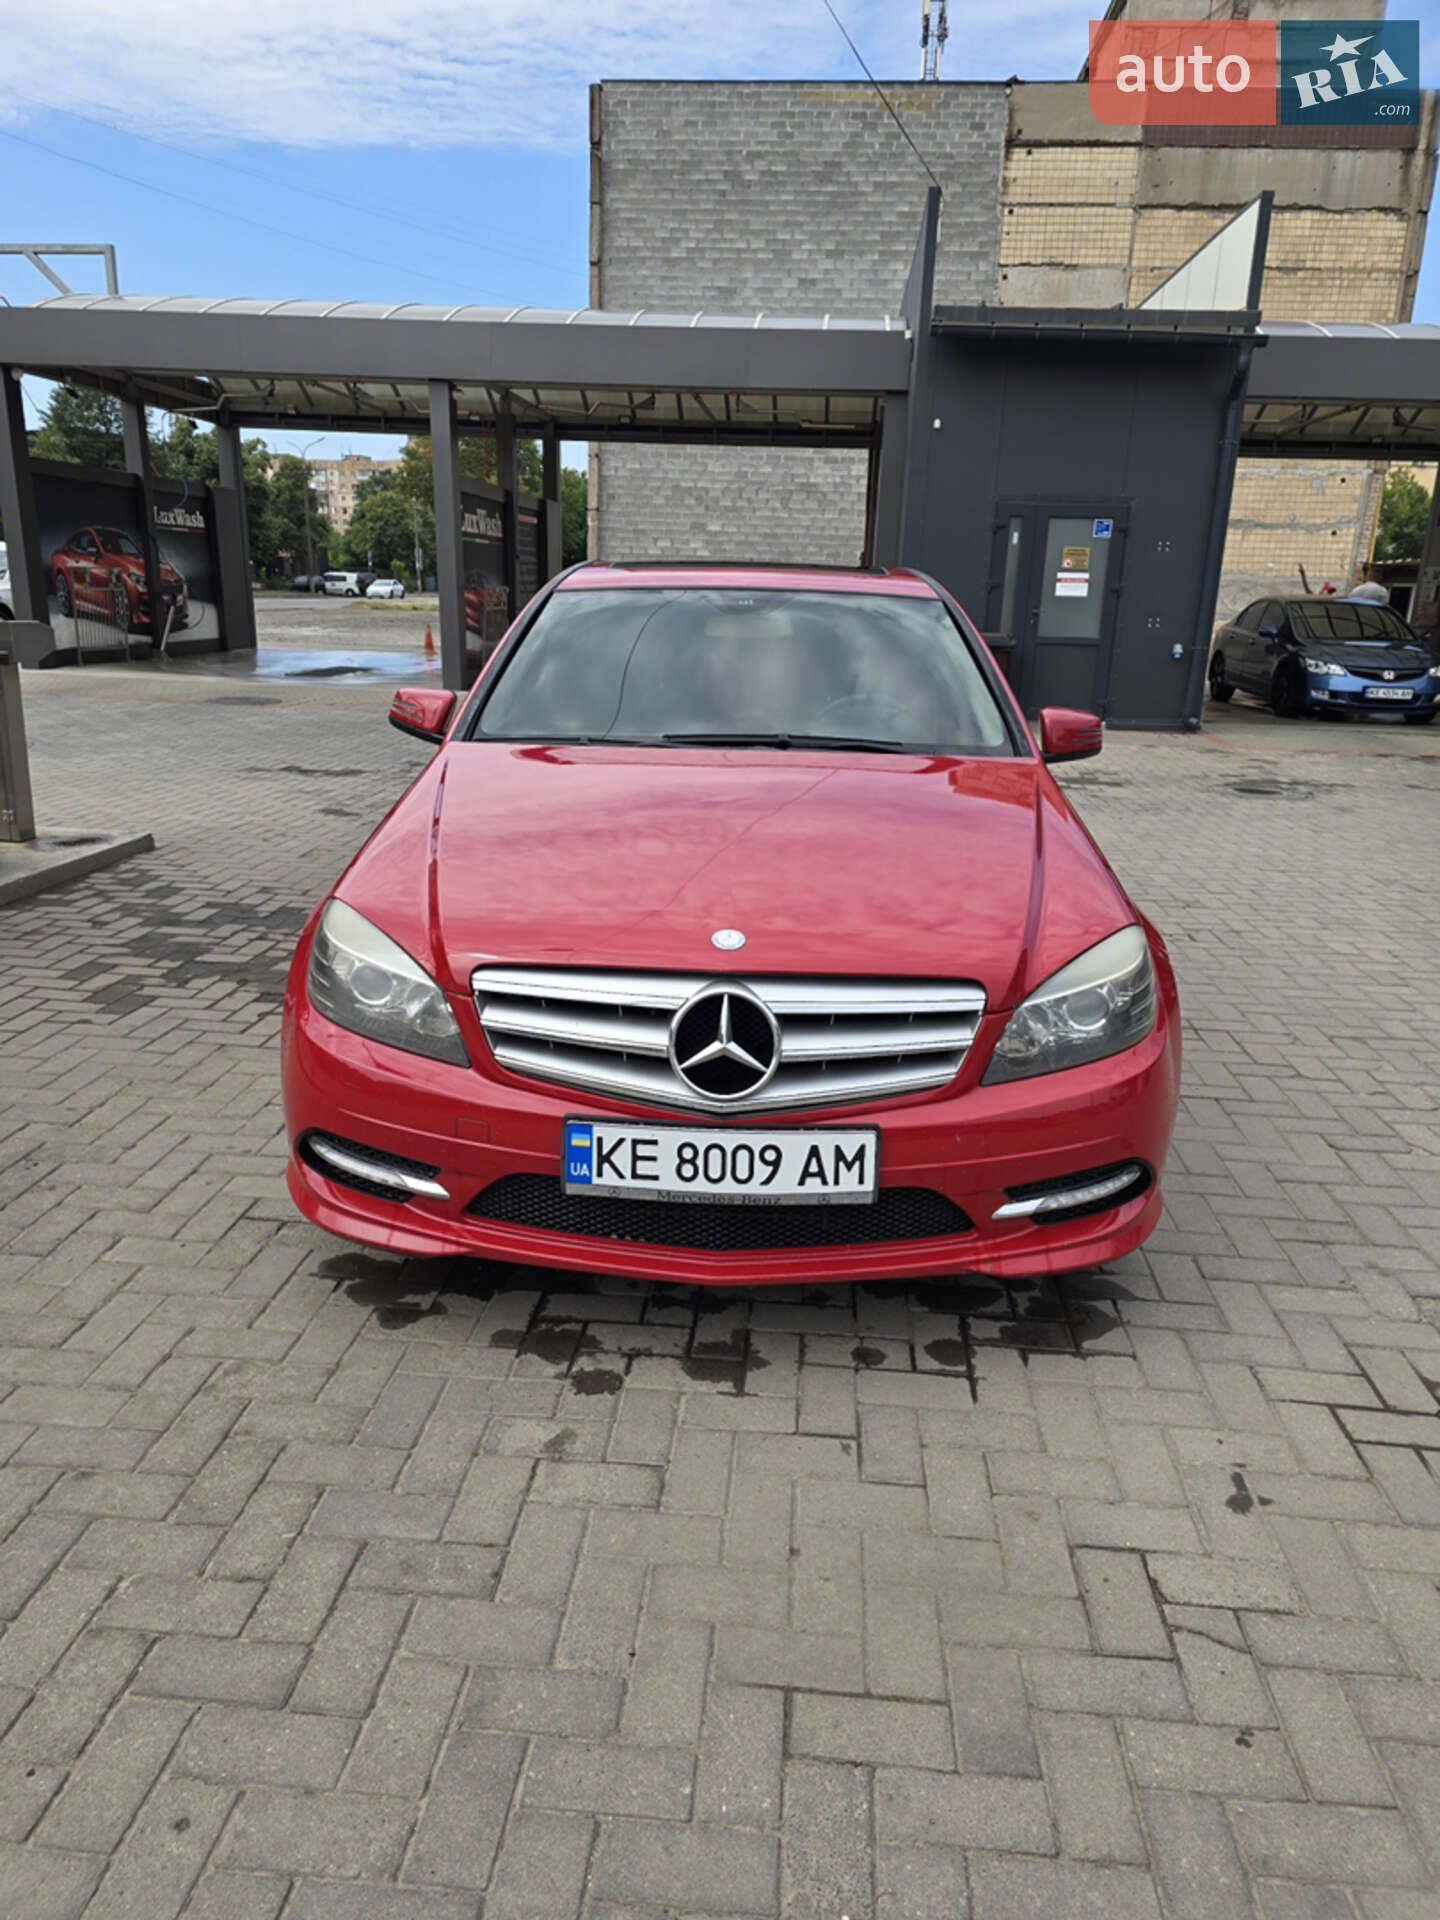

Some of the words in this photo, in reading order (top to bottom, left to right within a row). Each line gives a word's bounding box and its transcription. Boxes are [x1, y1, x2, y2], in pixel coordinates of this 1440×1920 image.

[570, 1163, 590, 1177] UA
[596, 1136, 660, 1181] KE
[676, 1141, 783, 1187] 8009
[797, 1143, 867, 1187] AM
